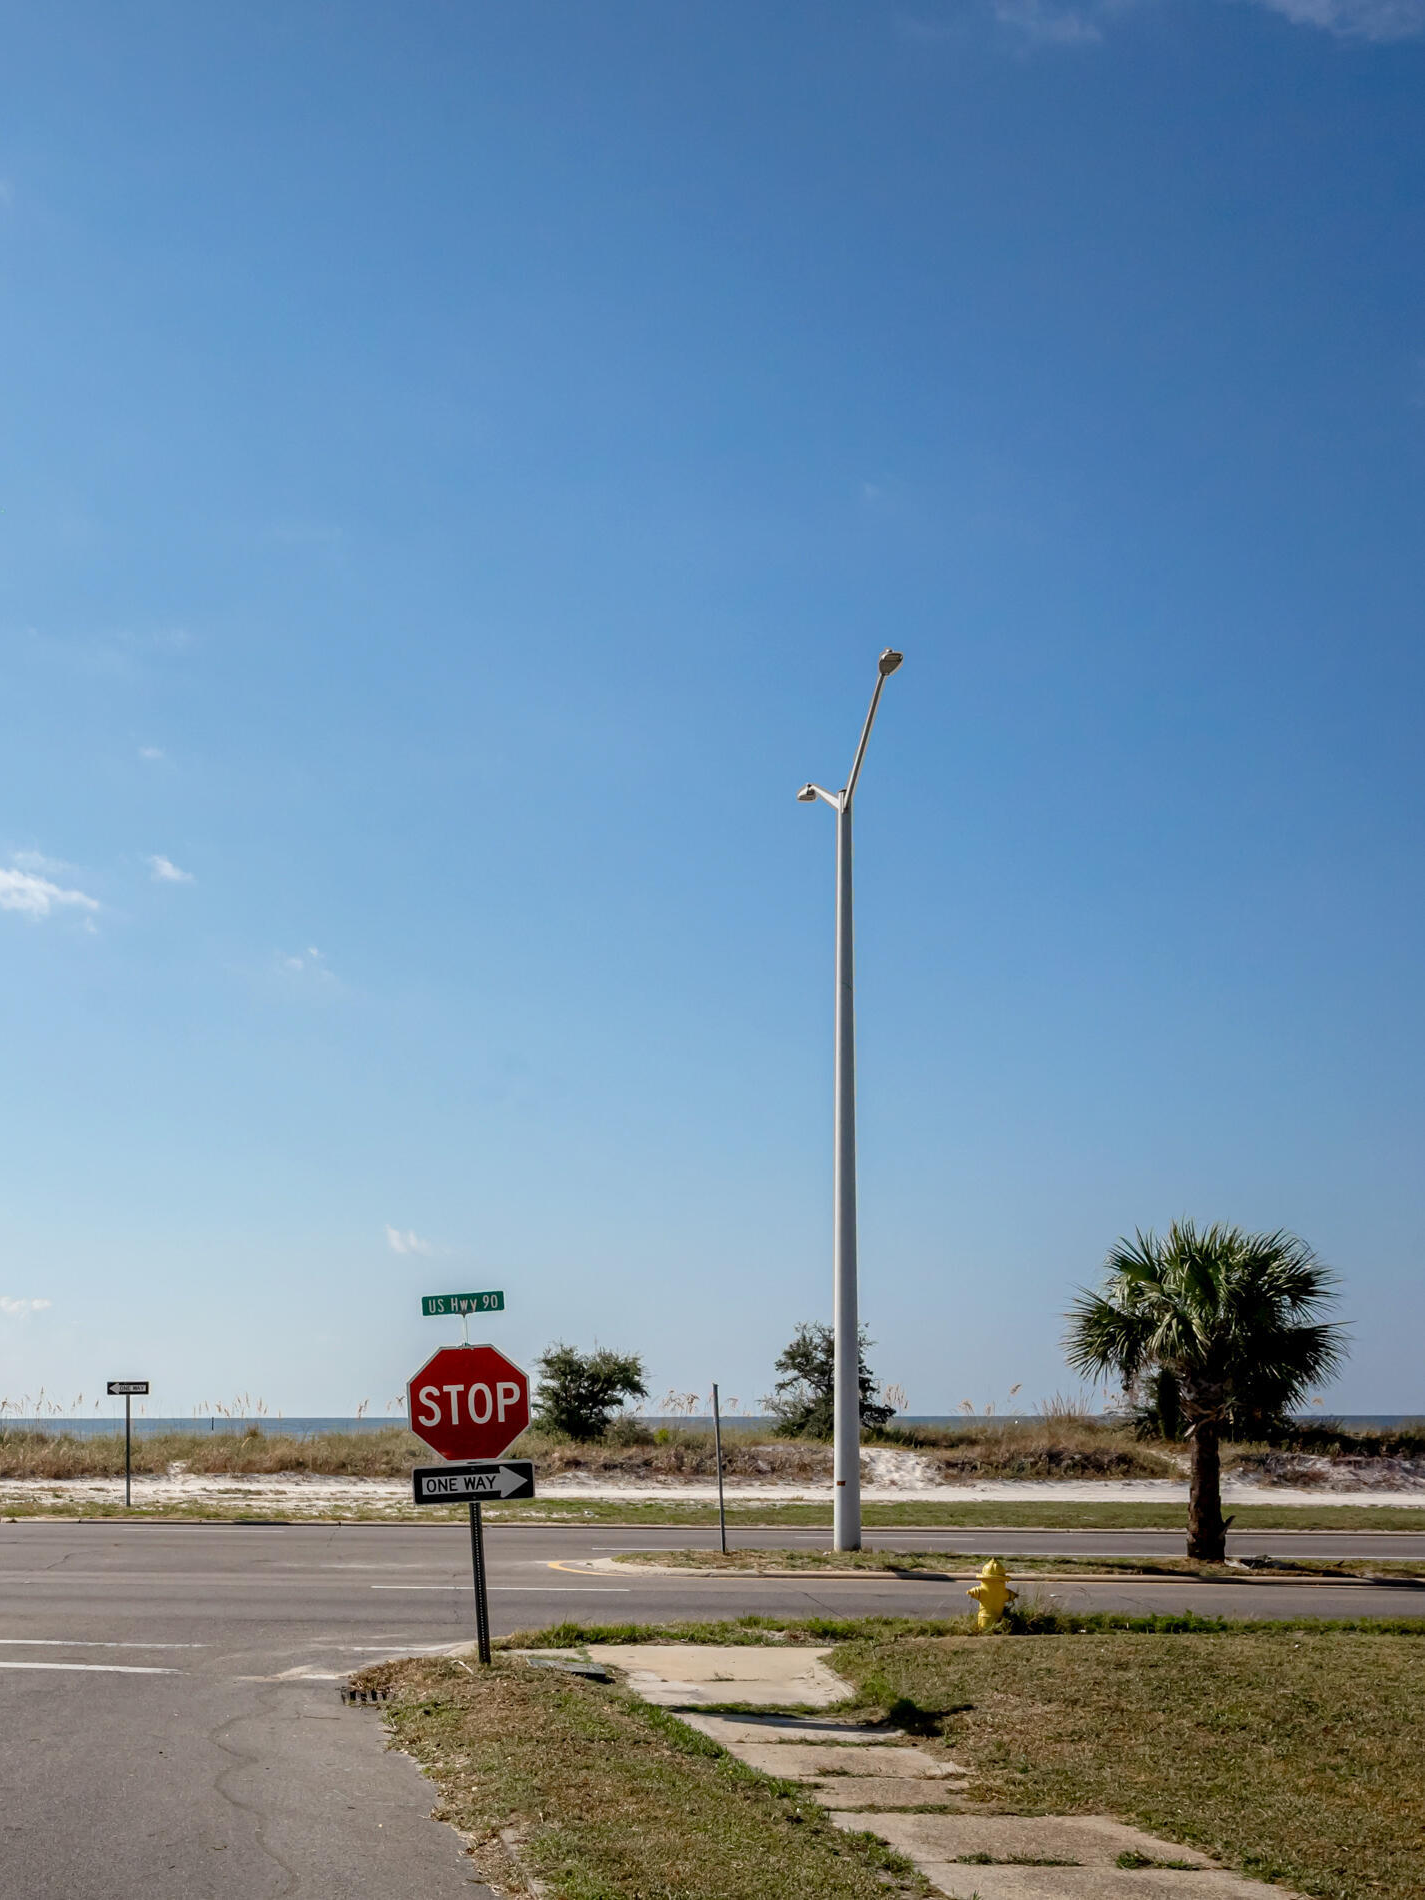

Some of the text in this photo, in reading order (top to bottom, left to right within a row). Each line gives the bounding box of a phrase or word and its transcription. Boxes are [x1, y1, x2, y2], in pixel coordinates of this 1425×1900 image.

[428, 1294, 498, 1314] US Hwy 90
[418, 1382, 521, 1427] STOP
[426, 1475, 496, 1493] ONE WAY
